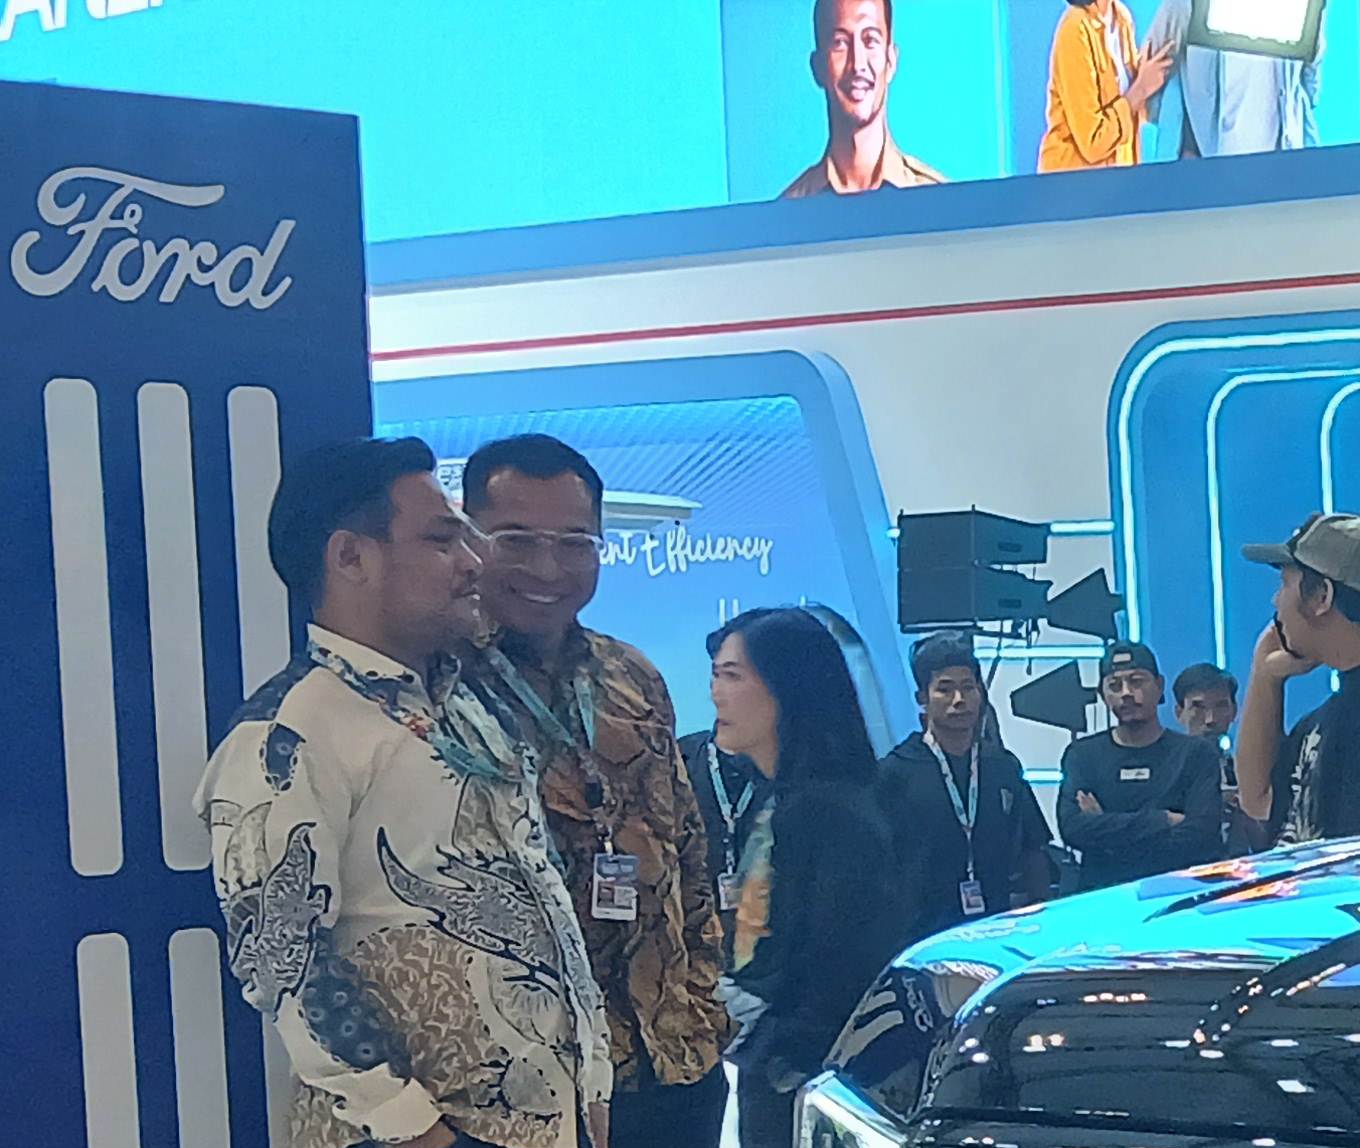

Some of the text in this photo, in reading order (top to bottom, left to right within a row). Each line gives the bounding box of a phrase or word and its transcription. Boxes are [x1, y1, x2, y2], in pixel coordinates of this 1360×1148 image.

[10, 166, 297, 310] Ford
[599, 526, 773, 576] ent Efficiency
